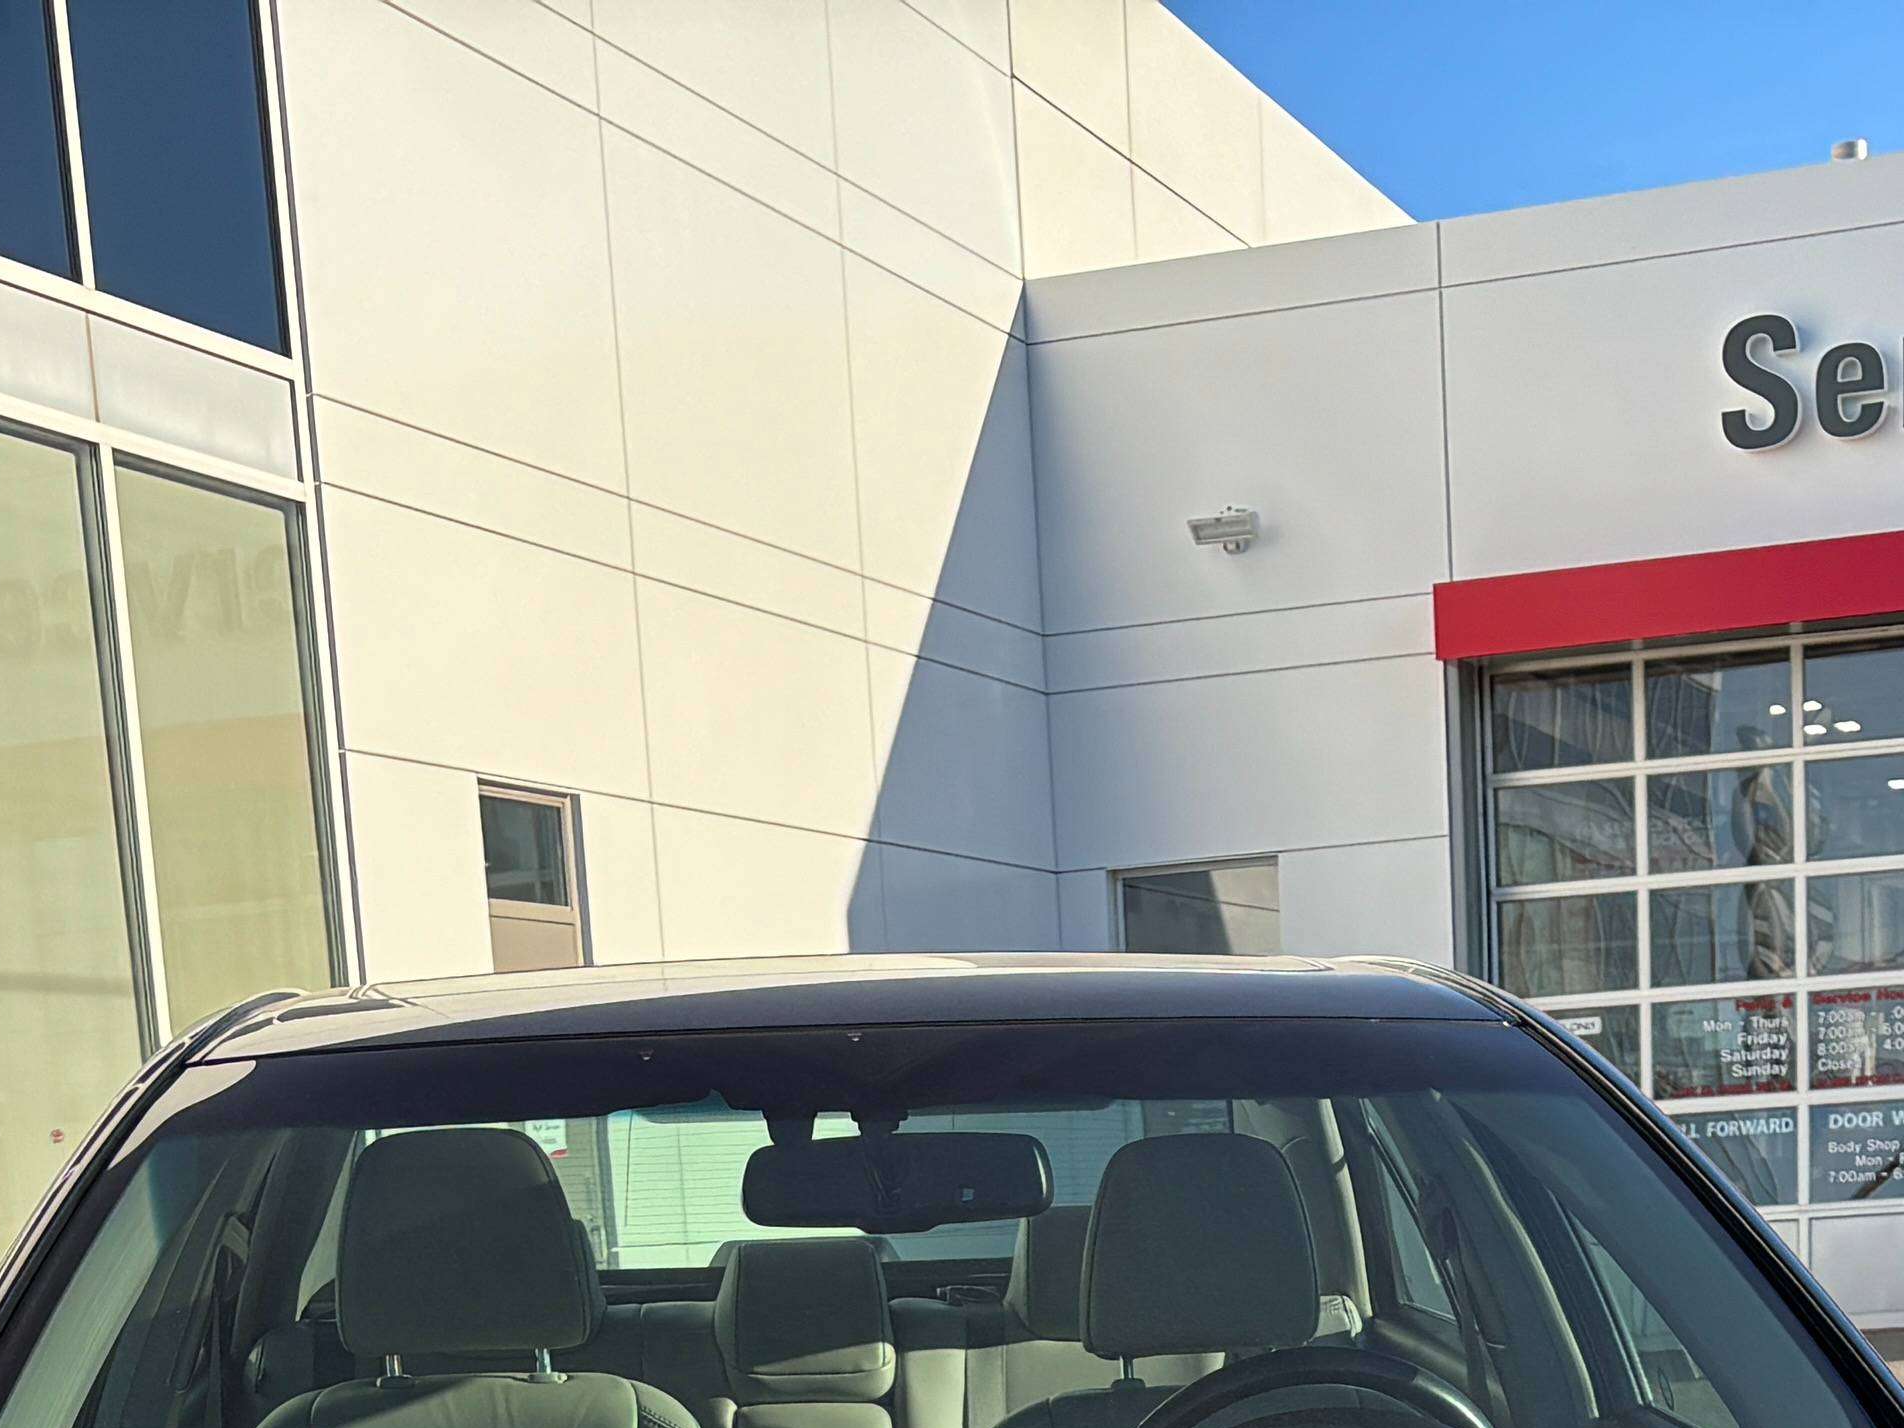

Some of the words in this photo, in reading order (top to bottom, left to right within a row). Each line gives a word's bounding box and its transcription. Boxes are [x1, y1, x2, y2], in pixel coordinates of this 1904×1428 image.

[1703, 1020, 1732, 1032] Mon
[1737, 1032, 1788, 1045] Friday
[1720, 1046, 1790, 1062] Saturday
[1731, 1063, 1788, 1078] Sunday
[1681, 1122, 1700, 1138] LL
[1706, 1117, 1794, 1137] FORWARD
[1829, 1111, 1883, 1129] DOOR
[1828, 1140, 1862, 1154] Body
[1866, 1138, 1900, 1152] Shop
[1855, 1155, 1883, 1167] Mon
